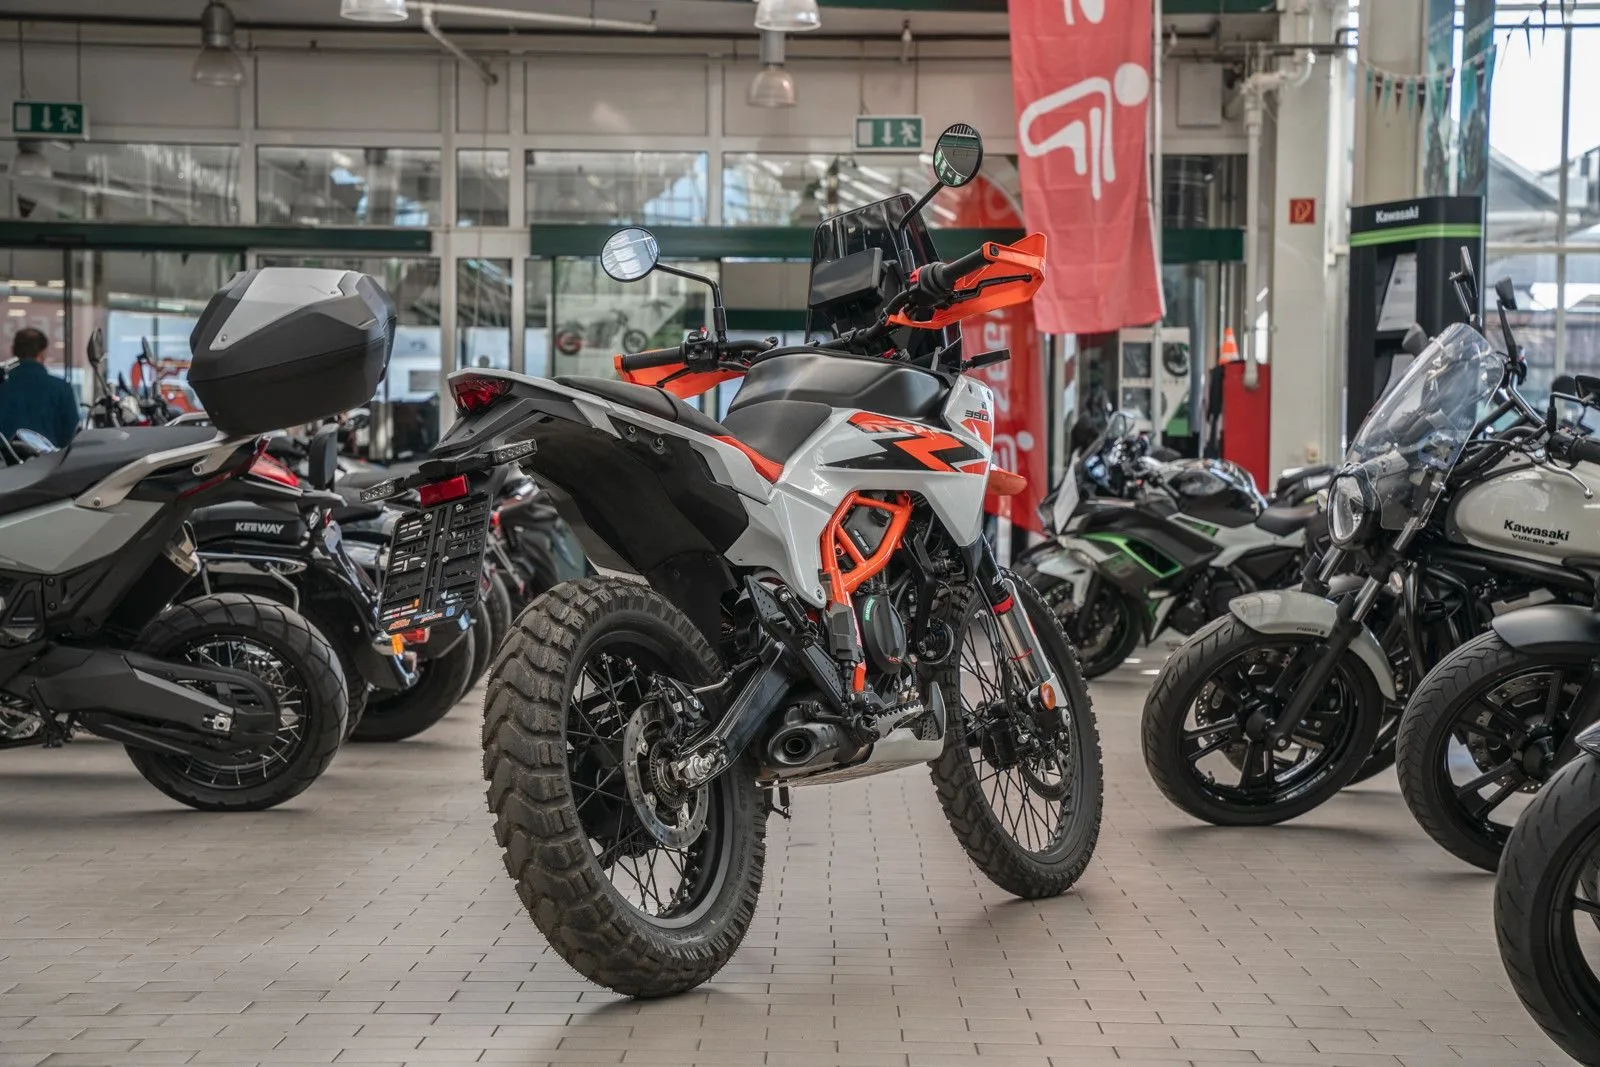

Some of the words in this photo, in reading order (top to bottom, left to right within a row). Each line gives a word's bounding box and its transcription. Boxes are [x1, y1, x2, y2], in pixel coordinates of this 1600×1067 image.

[1375, 206, 1419, 223] Kawasaki
[964, 409, 989, 421] 390
[235, 521, 284, 535] KEEWAY
[1503, 519, 1570, 541] Kawasaki
